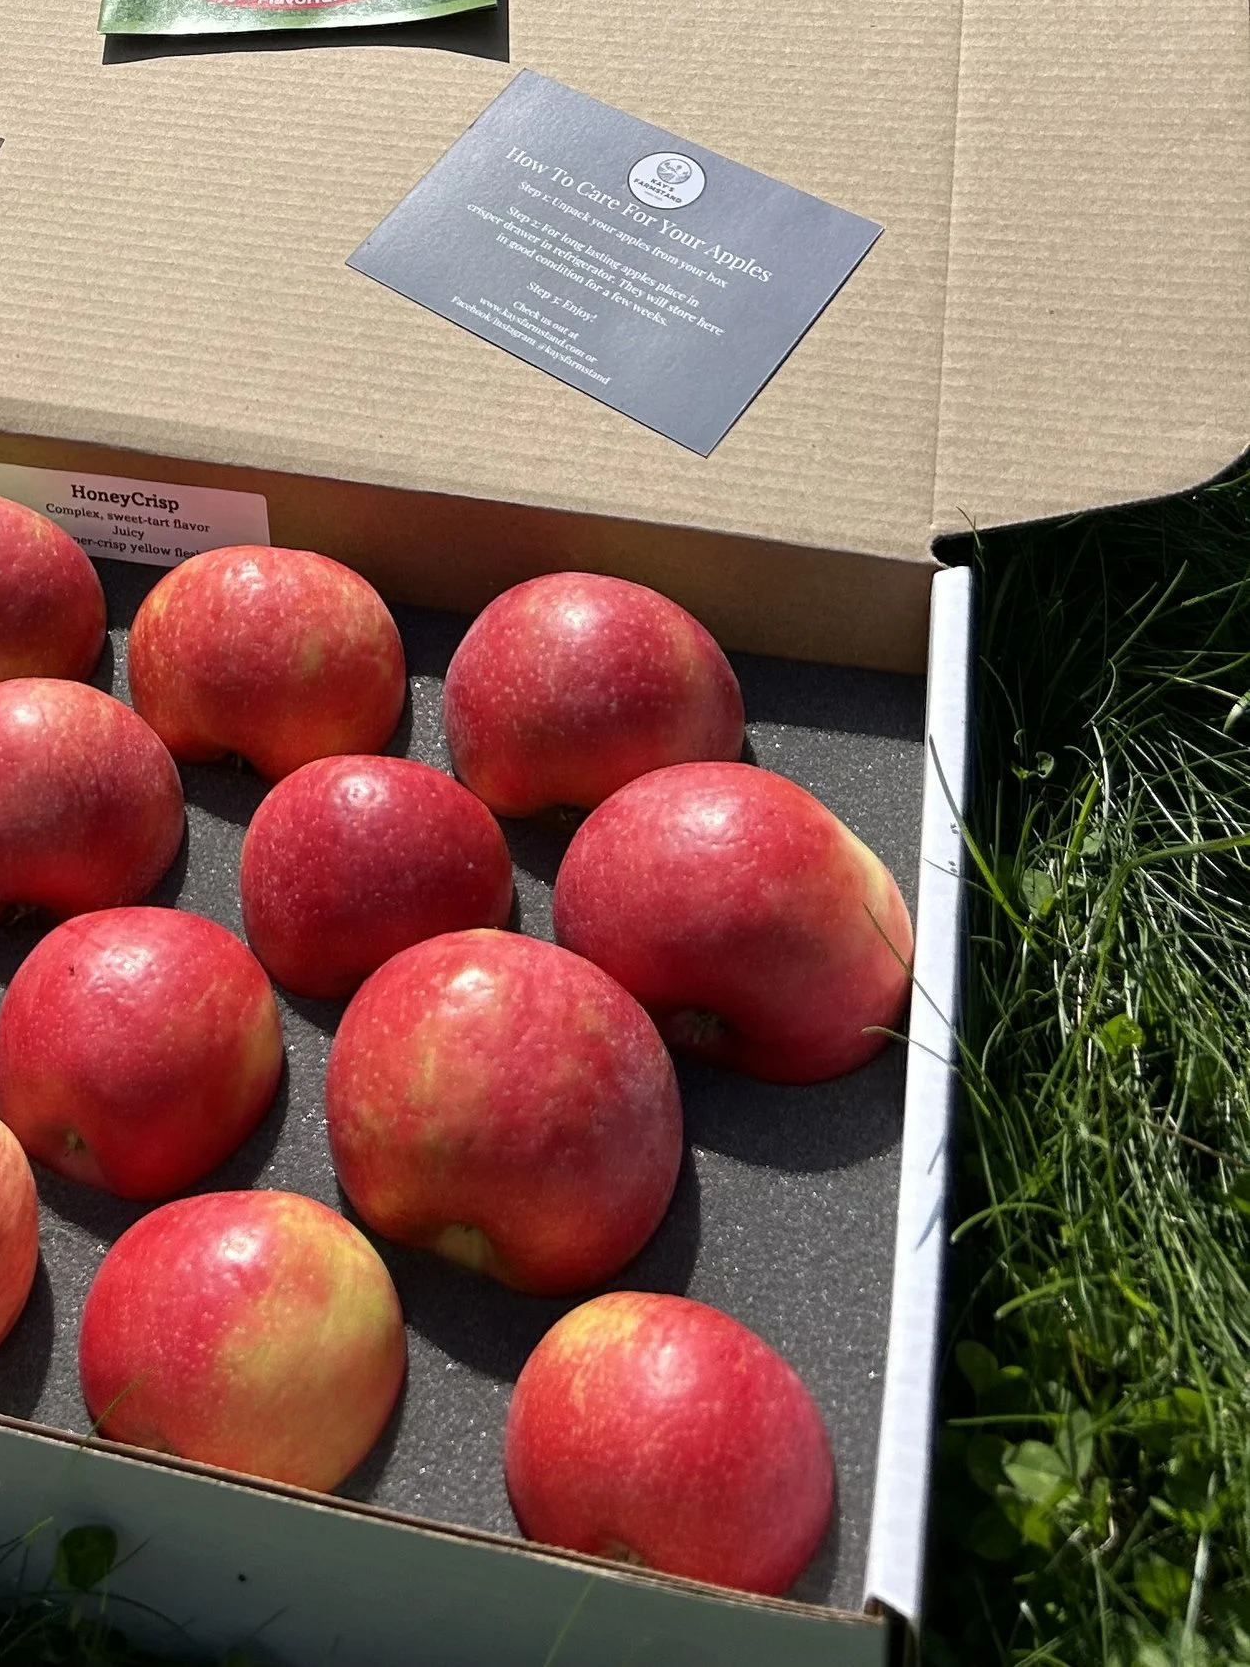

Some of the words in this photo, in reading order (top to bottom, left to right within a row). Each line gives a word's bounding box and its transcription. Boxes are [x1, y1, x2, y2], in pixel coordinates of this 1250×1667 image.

[633, 178, 682, 203] FARMSTAND
[650, 178, 675, 192] KAY'S
[505, 145, 549, 174] How
[550, 167, 574, 187] To
[576, 181, 620, 210] Care
[621, 202, 658, 227] For
[659, 218, 706, 250] Your
[704, 244, 773, 283] Apples
[518, 181, 542, 198] Step
[551, 197, 591, 222] Unpack
[589, 218, 617, 235] your
[616, 230, 652, 252] apples
[651, 246, 679, 265] from
[678, 261, 706, 278] your
[706, 271, 728, 288] box
[467, 203, 504, 225] crisper
[503, 221, 542, 244] drawer
[540, 239, 553, 250] in
[552, 246, 615, 284] refrigerator.
[618, 278, 646, 298] They
[646, 293, 669, 309] will
[667, 304, 698, 323] store
[696, 316, 726, 336] here
[506, 206, 531, 223] Step
[541, 223, 561, 238] For
[560, 233, 585, 252] long
[584, 244, 622, 270] lasting
[620, 264, 657, 287] apples
[655, 281, 687, 301] place
[686, 295, 700, 308] in
[495, 232, 509, 245] in
[508, 240, 536, 258] good
[535, 254, 585, 285] condition
[585, 279, 603, 292] for
[602, 289, 611, 297] a
[610, 291, 633, 307] few
[633, 303, 668, 326] weeks.
[513, 300, 541, 321] Check
[540, 316, 552, 326] us
[552, 321, 569, 335] out
[567, 331, 580, 340] at
[526, 281, 551, 300] Step
[561, 299, 598, 323] Enjoy!
[450, 295, 536, 347] Facebook/Instagram
[536, 343, 612, 386] @kaysfarmstand
[479, 297, 585, 358] www.kaysfarmstand.com
[584, 353, 598, 364] or
[46, 503, 104, 520] Complex,
[107, 513, 170, 527] sweet-tart
[173, 519, 211, 532] flavor
[71, 484, 179, 513] HoneyCrisp
[112, 526, 144, 540] Juicy
[130, 543, 171, 556] yellow
